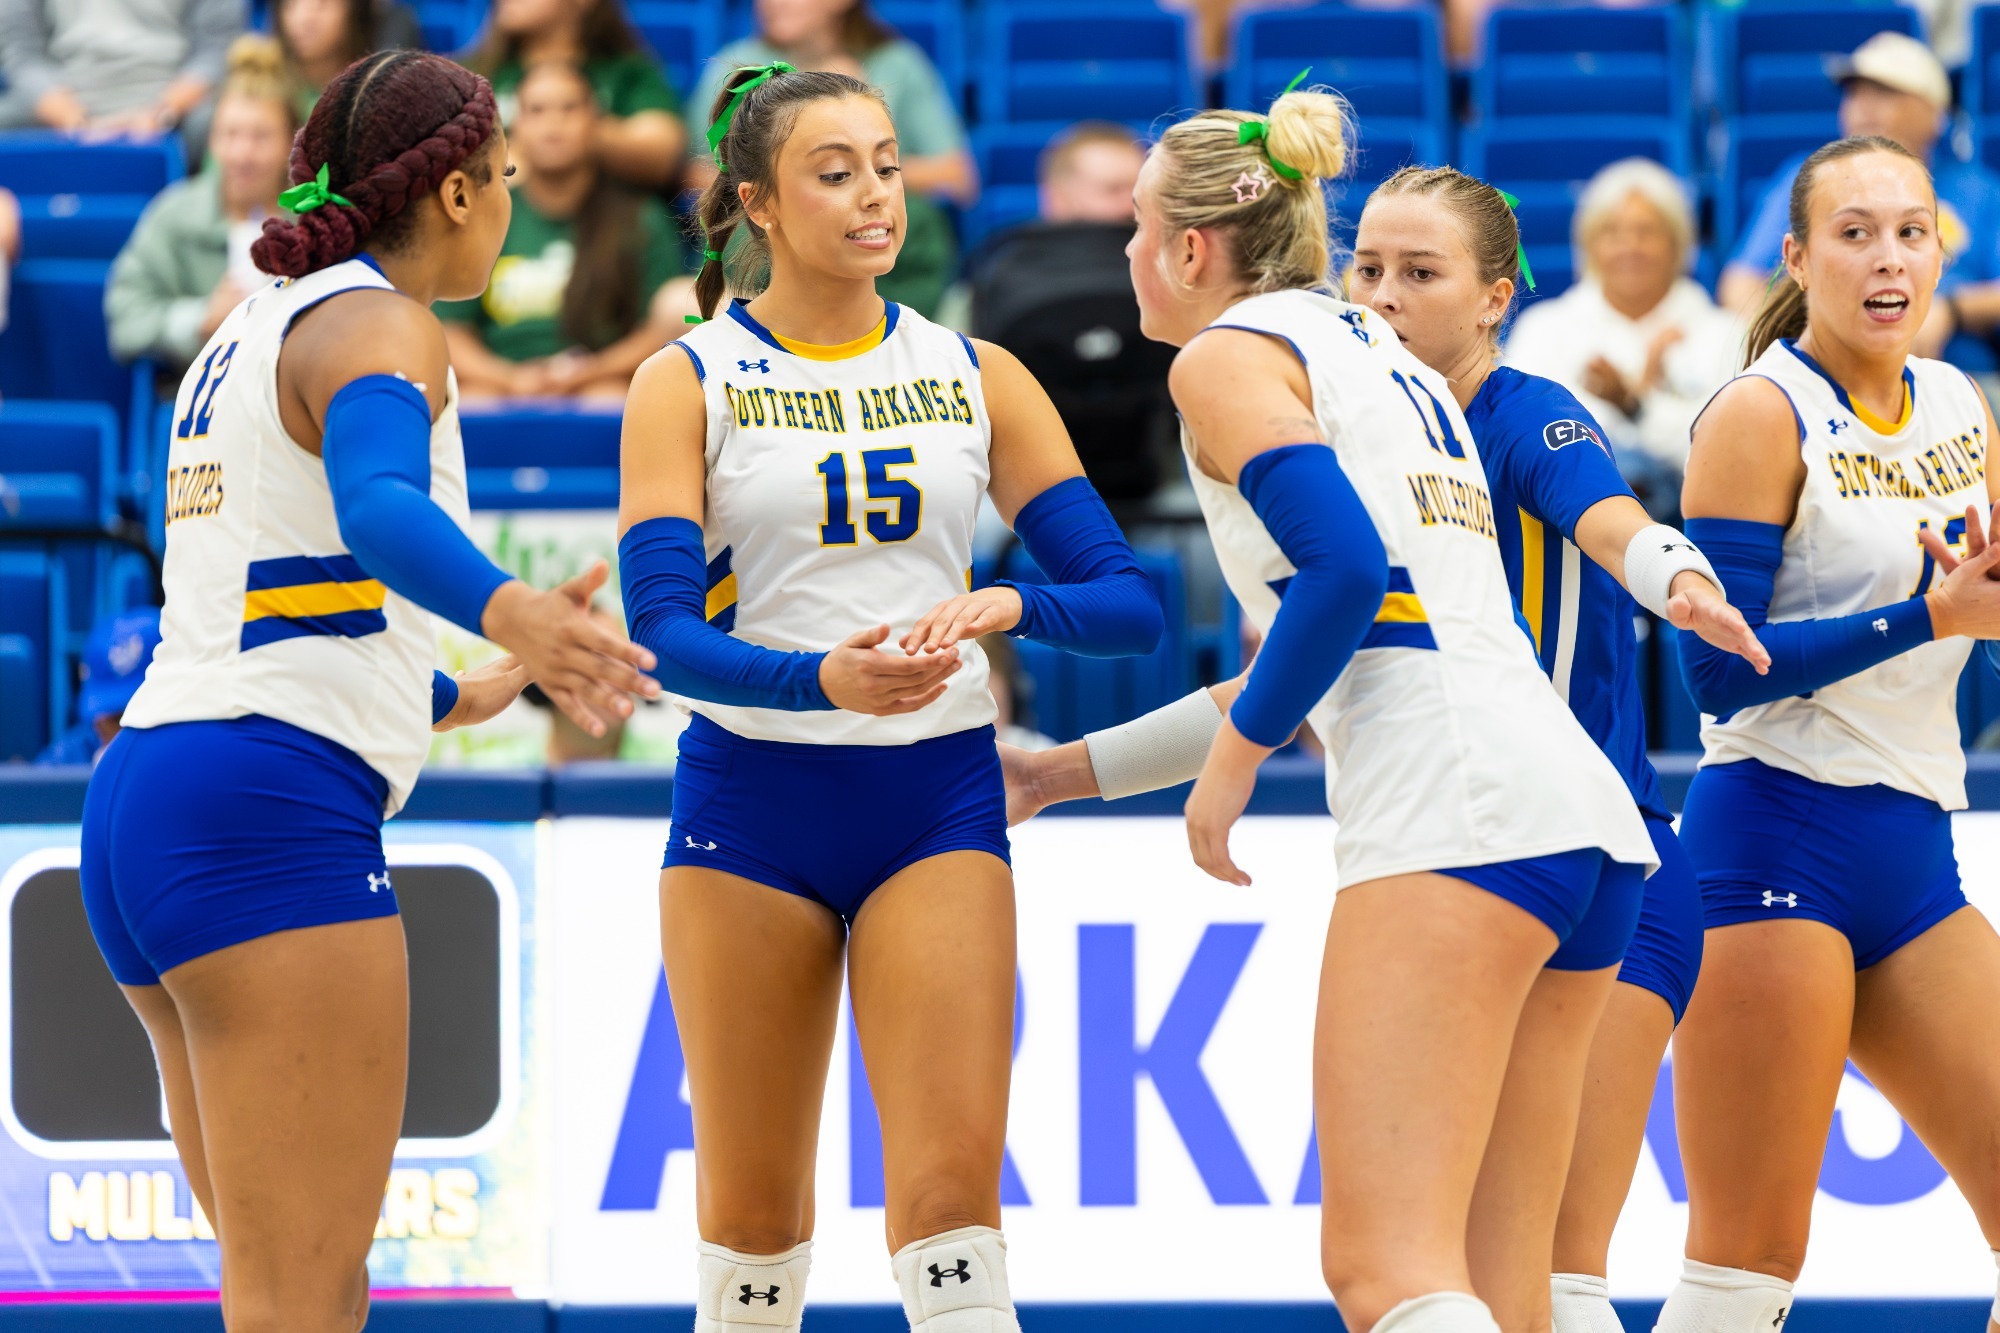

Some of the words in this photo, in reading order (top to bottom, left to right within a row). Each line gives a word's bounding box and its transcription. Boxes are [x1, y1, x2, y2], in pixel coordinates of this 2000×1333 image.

[177, 339, 241, 440] 12
[1389, 368, 1467, 461] 11
[815, 445, 923, 547] 15
